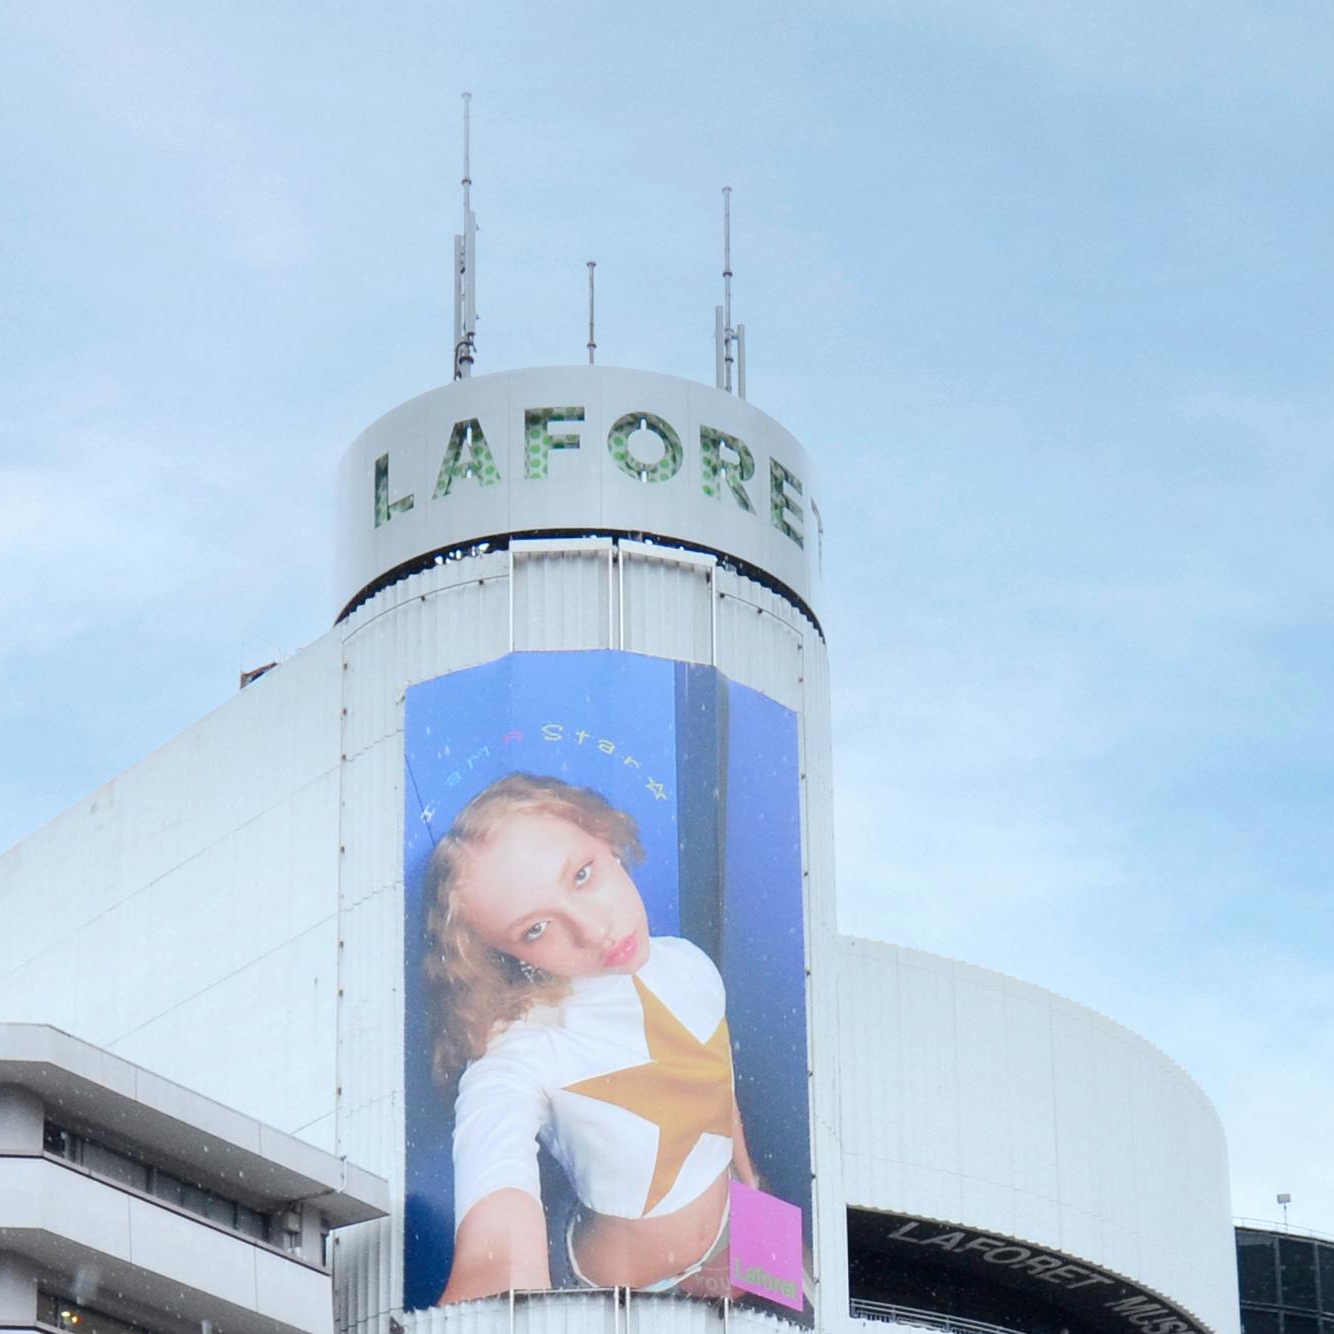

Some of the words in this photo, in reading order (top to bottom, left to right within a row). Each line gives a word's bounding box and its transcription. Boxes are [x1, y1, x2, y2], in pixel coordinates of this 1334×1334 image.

[373, 405, 825, 560] LAFORE
[733, 1257, 799, 1299] Laforet
[888, 1220, 1119, 1290] LAFORET
